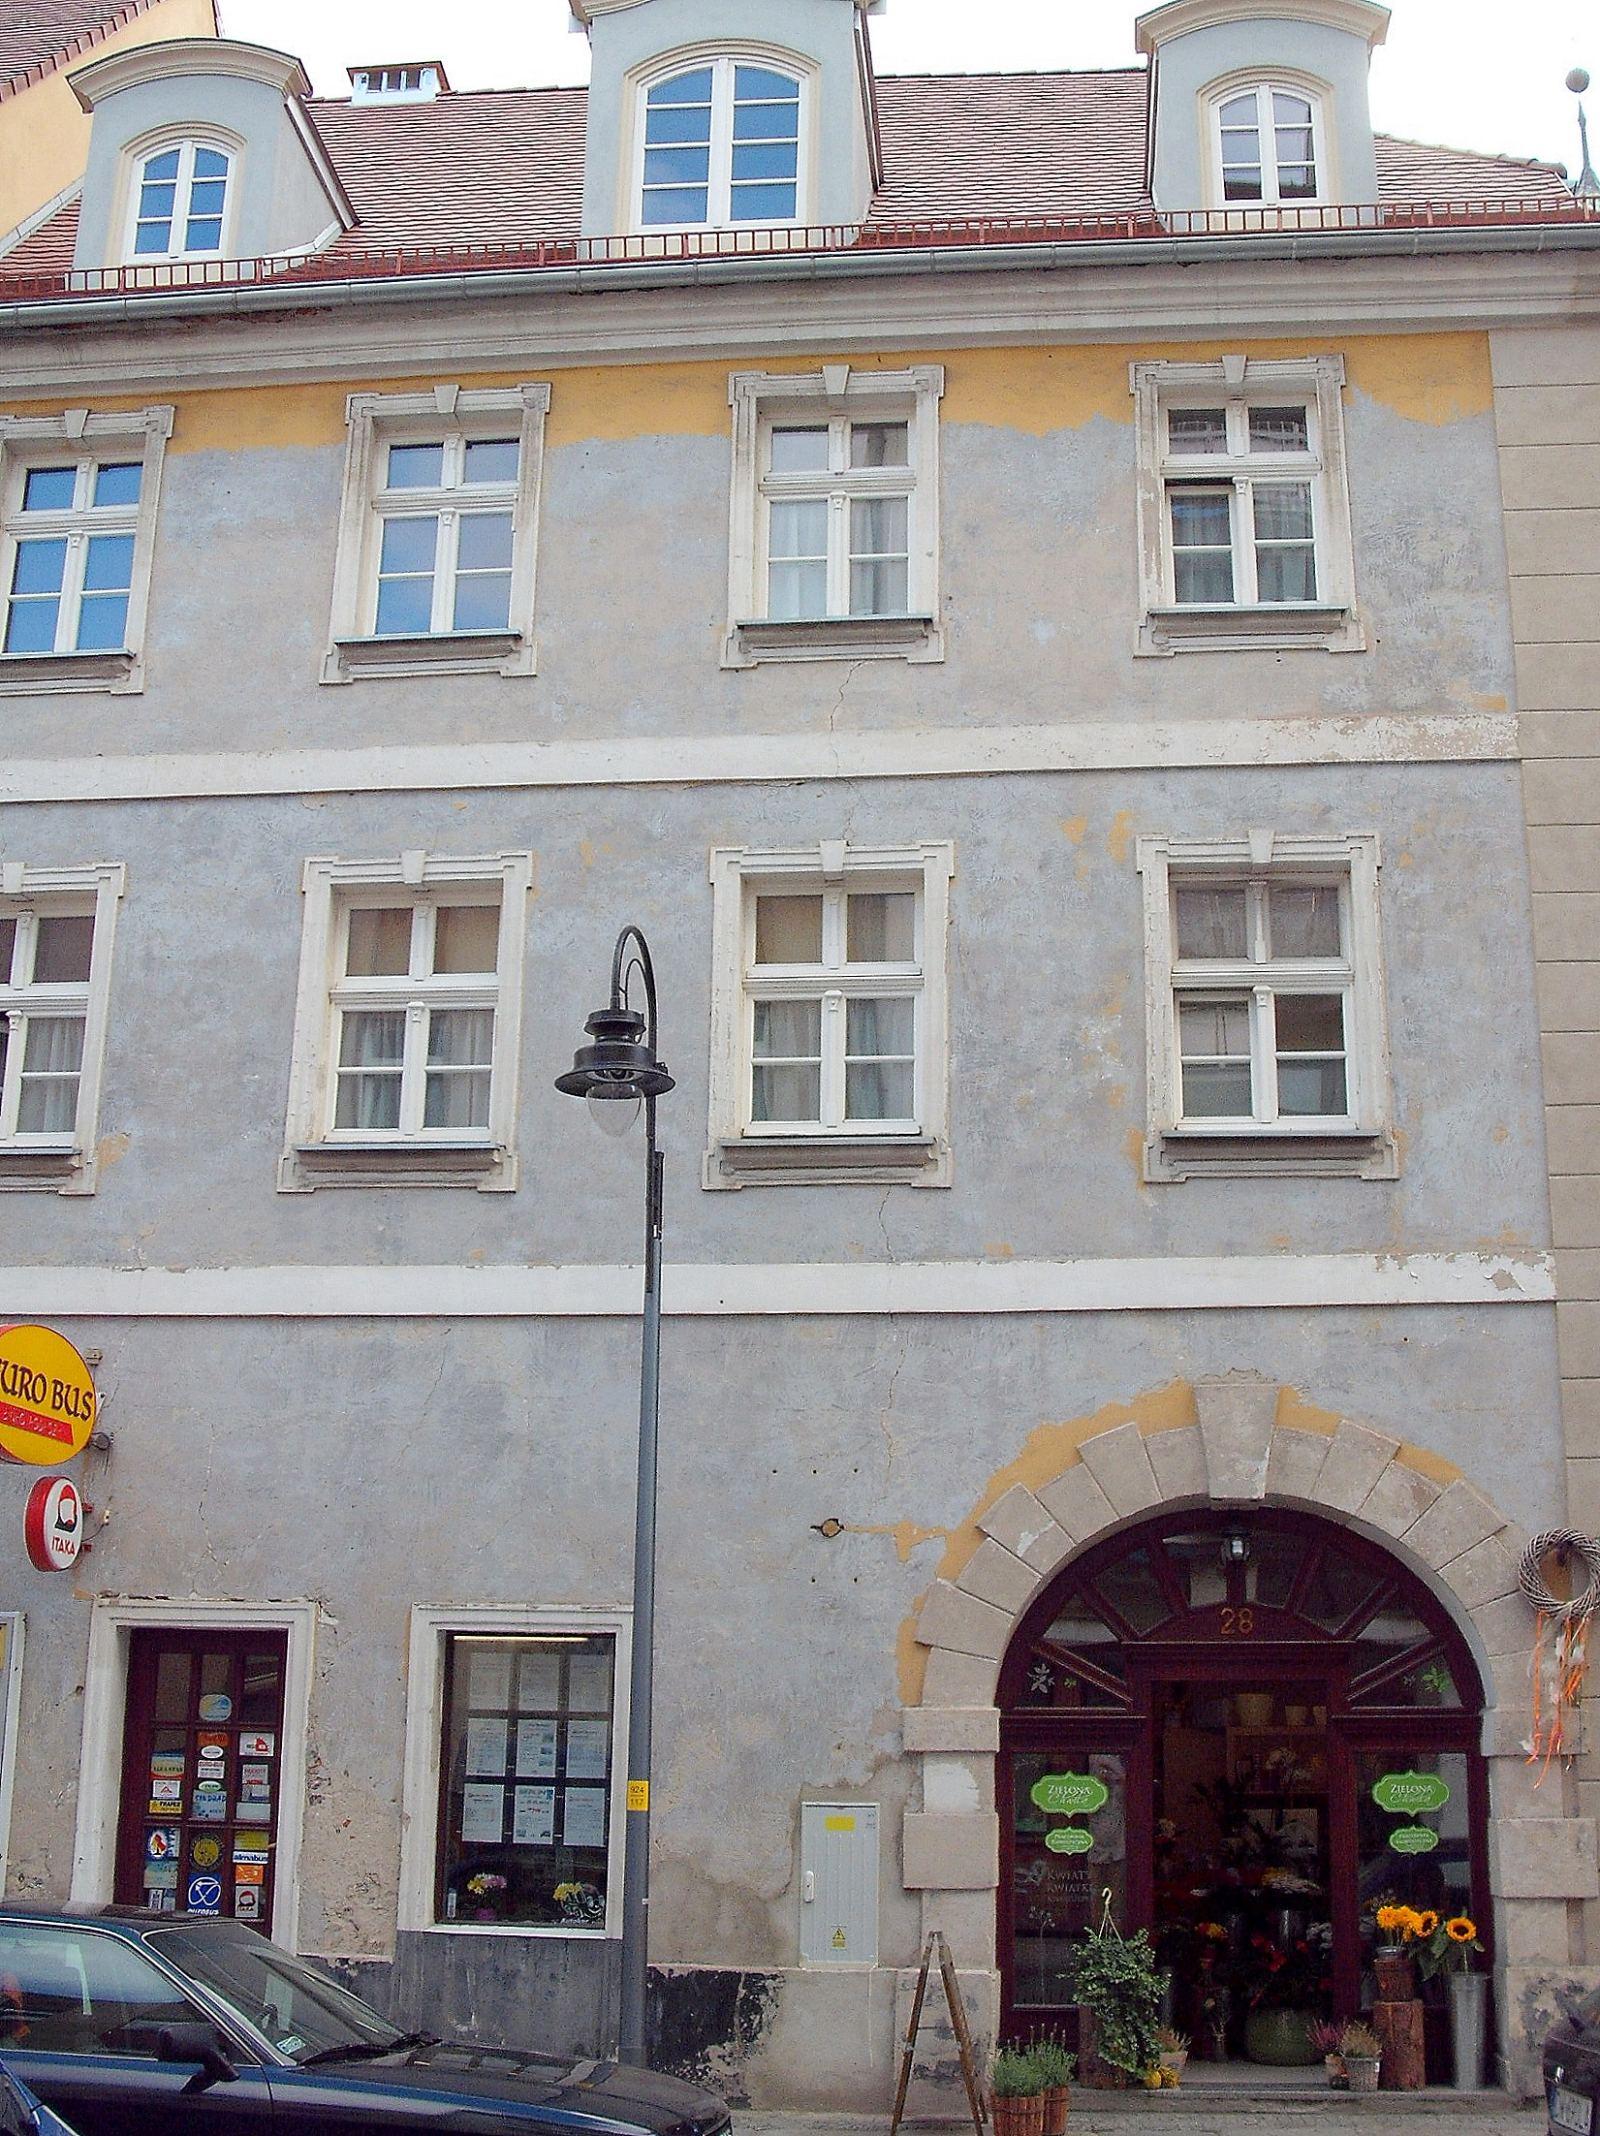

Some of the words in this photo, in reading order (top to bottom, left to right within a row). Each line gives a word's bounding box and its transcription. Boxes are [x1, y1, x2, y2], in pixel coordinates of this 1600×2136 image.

[0, 1358, 47, 1405] URO
[51, 1378, 94, 1422] BUS
[51, 1535, 76, 1556] ITAKA
[1220, 1607, 1254, 1635] 28
[1047, 1784, 1093, 1795] ZIELONA
[1390, 1784, 1434, 1793] ZIELONA
